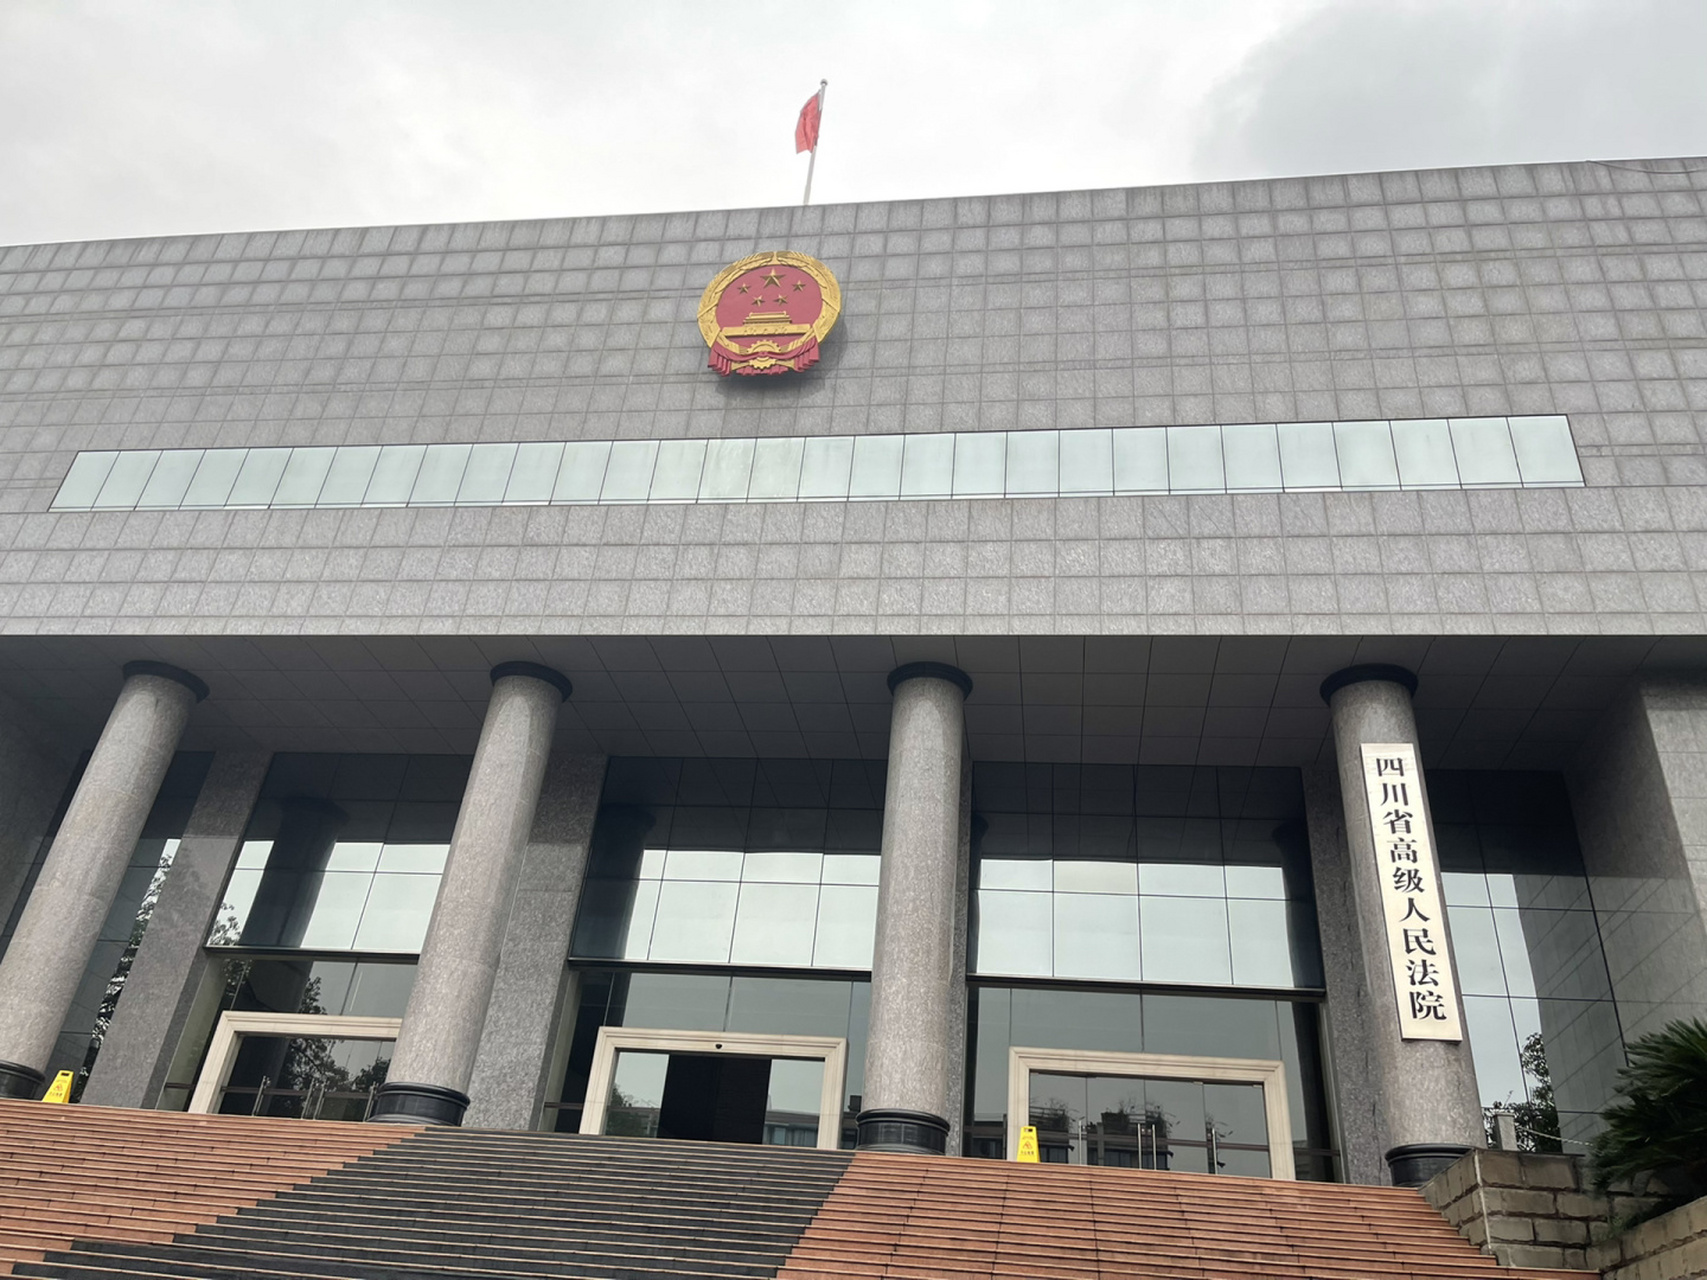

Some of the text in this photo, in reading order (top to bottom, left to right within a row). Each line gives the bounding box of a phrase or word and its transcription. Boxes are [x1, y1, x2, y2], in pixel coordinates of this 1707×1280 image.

[1375, 757, 1447, 1020] 四川省高级人民法院
